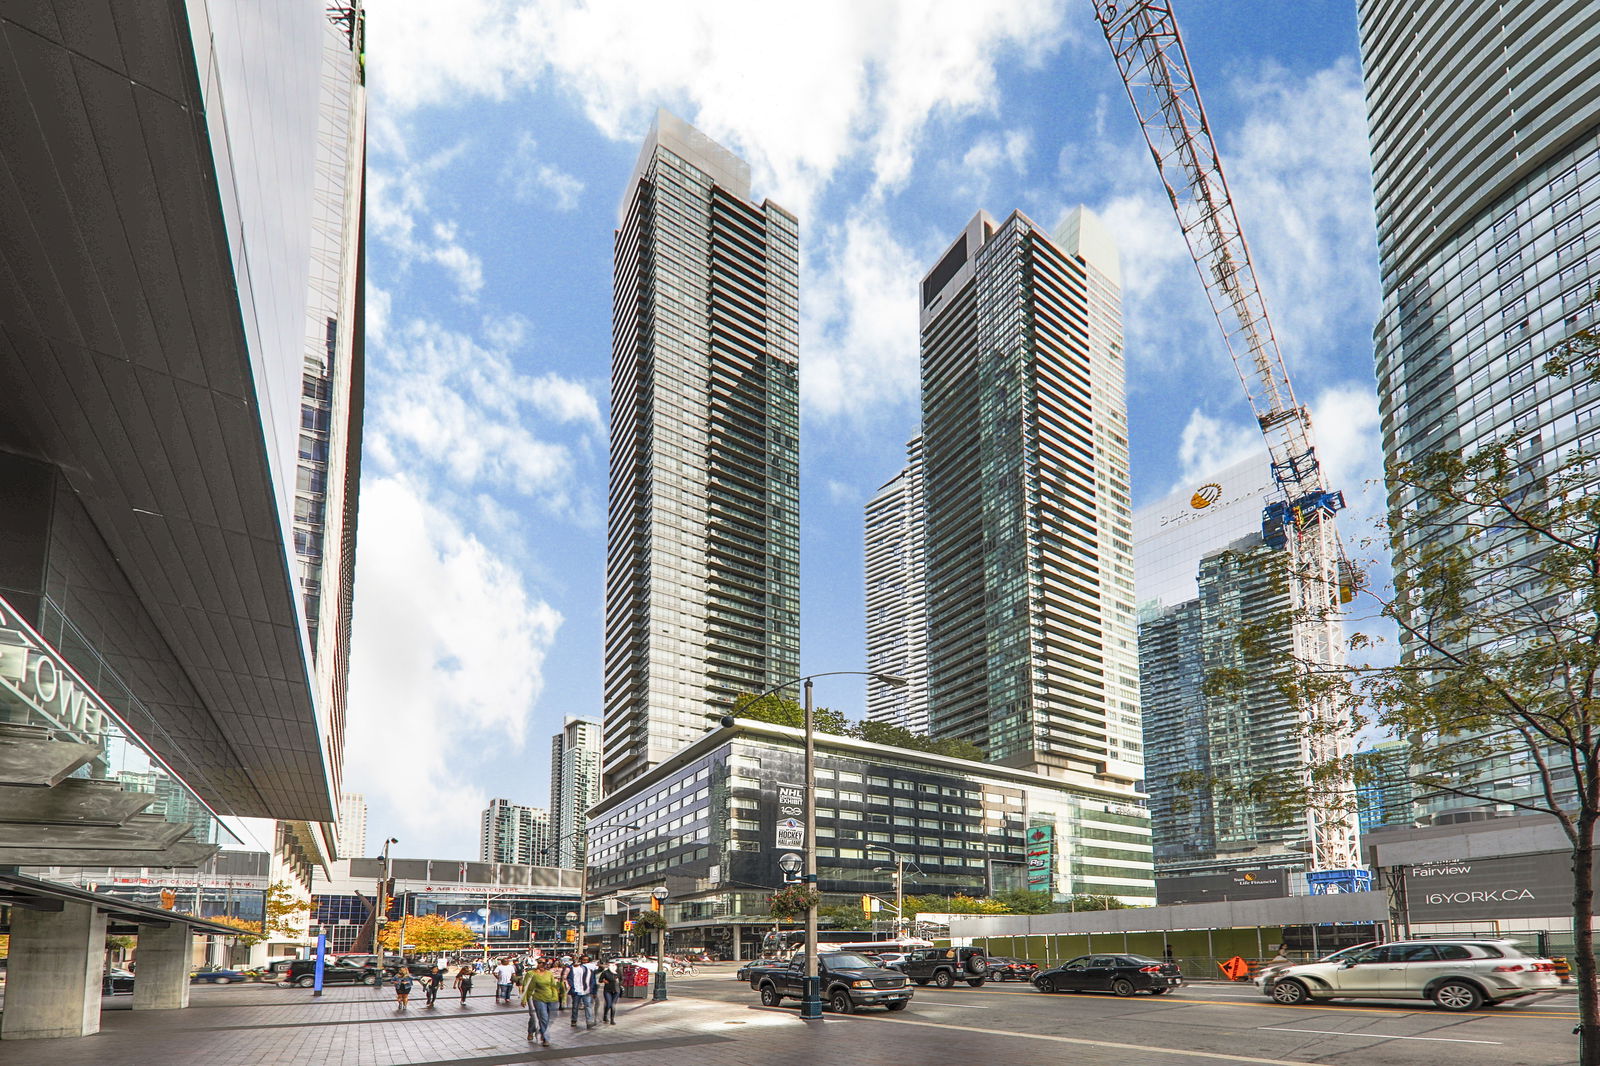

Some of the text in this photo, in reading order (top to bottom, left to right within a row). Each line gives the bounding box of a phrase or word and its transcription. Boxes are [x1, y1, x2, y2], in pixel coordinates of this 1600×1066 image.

[780, 788, 802, 797] NHL
[778, 831, 803, 840] HOCKEY
[1412, 866, 1471, 877] Fairview
[1426, 889, 1535, 904] 16YORK.CA
